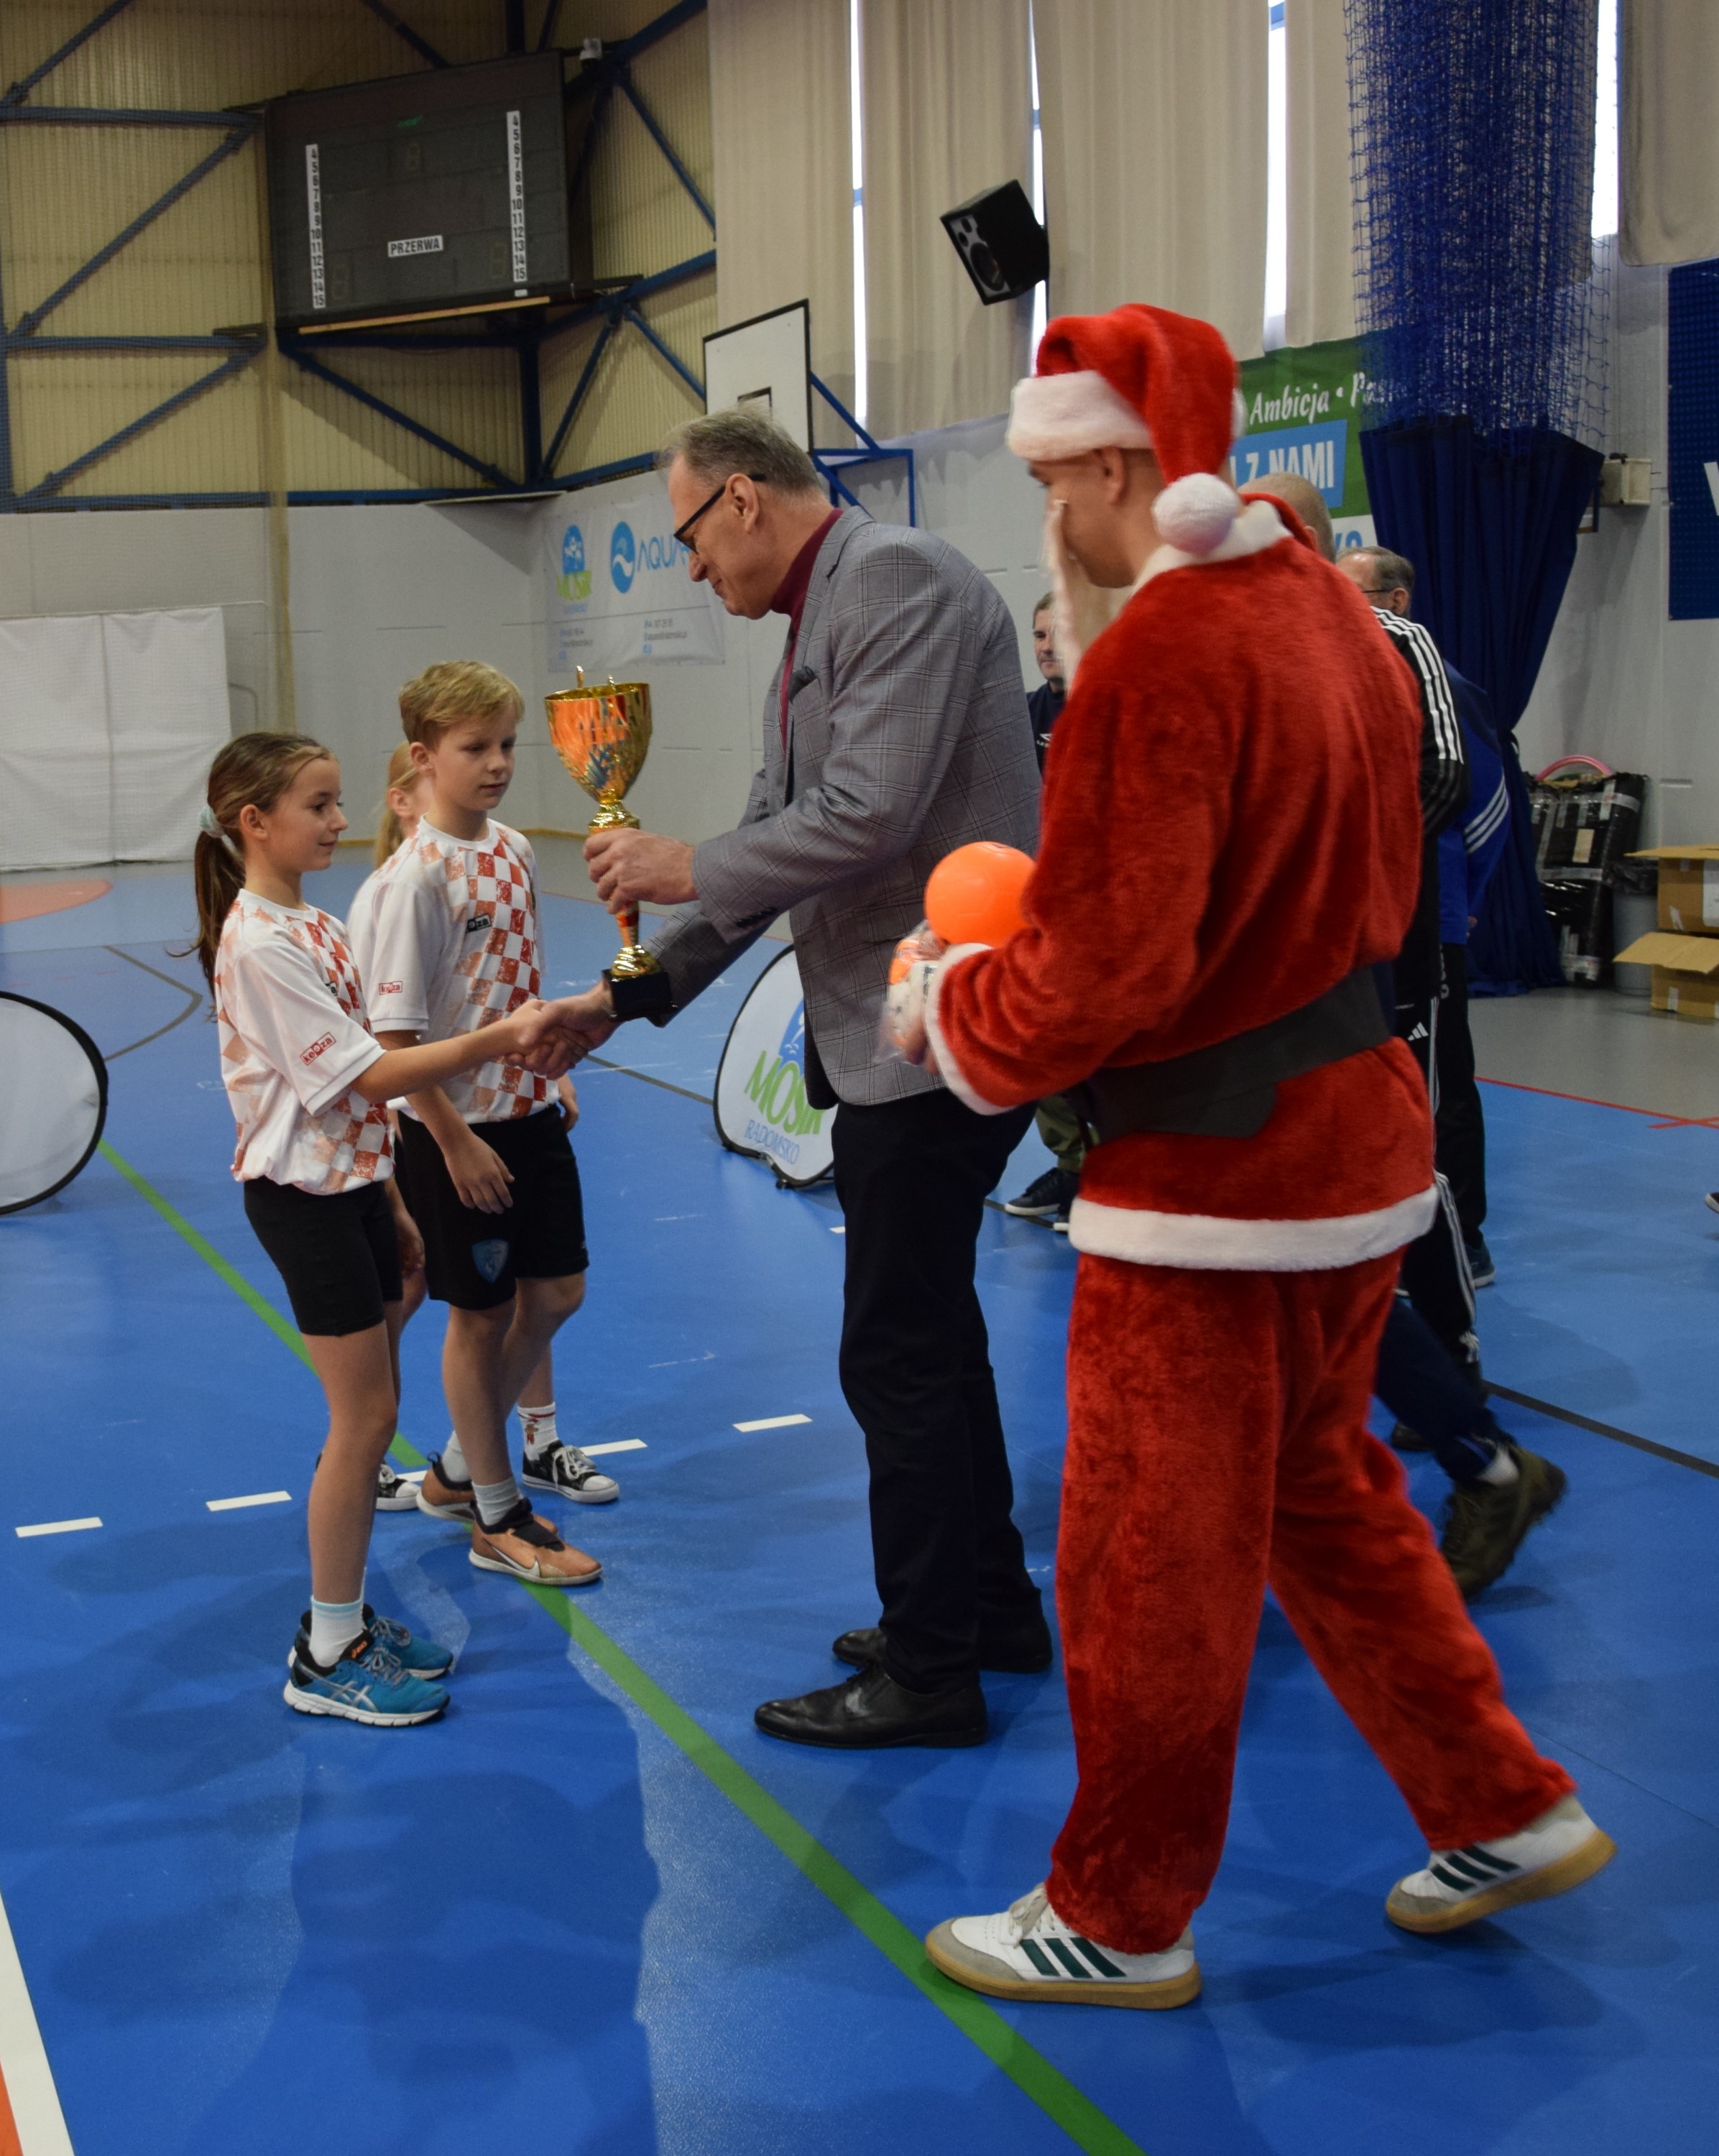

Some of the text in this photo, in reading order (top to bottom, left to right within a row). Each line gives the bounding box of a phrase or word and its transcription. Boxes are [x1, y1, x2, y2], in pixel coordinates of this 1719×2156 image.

[512, 114, 519, 126] 4
[513, 129, 520, 141] 5
[311, 148, 317, 159] 4
[514, 143, 520, 155] 6
[312, 161, 318, 173] 5
[515, 157, 520, 169] 7
[313, 175, 318, 186] 6
[515, 170, 521, 183] 8
[313, 188, 318, 200] 7
[516, 184, 522, 196] 9
[314, 201, 319, 213] 8
[512, 198, 522, 211] 10
[315, 215, 320, 226] 9
[513, 213, 522, 224] 11
[311, 228, 321, 239] 10
[513, 226, 524, 238] 12
[312, 241, 321, 253] 11
[390, 237, 440, 254] PRZERWA
[514, 239, 525, 252] 13
[312, 255, 322, 267] 12
[515, 254, 525, 266] 14
[313, 268, 323, 280] 13
[515, 268, 525, 280] 15
[313, 280, 323, 292] 14
[314, 294, 324, 306] 15
[1249, 382, 1329, 425] Ambicja
[1268, 441, 1335, 489] NAMI
[744, 1119, 801, 1165] RADOMSKO
